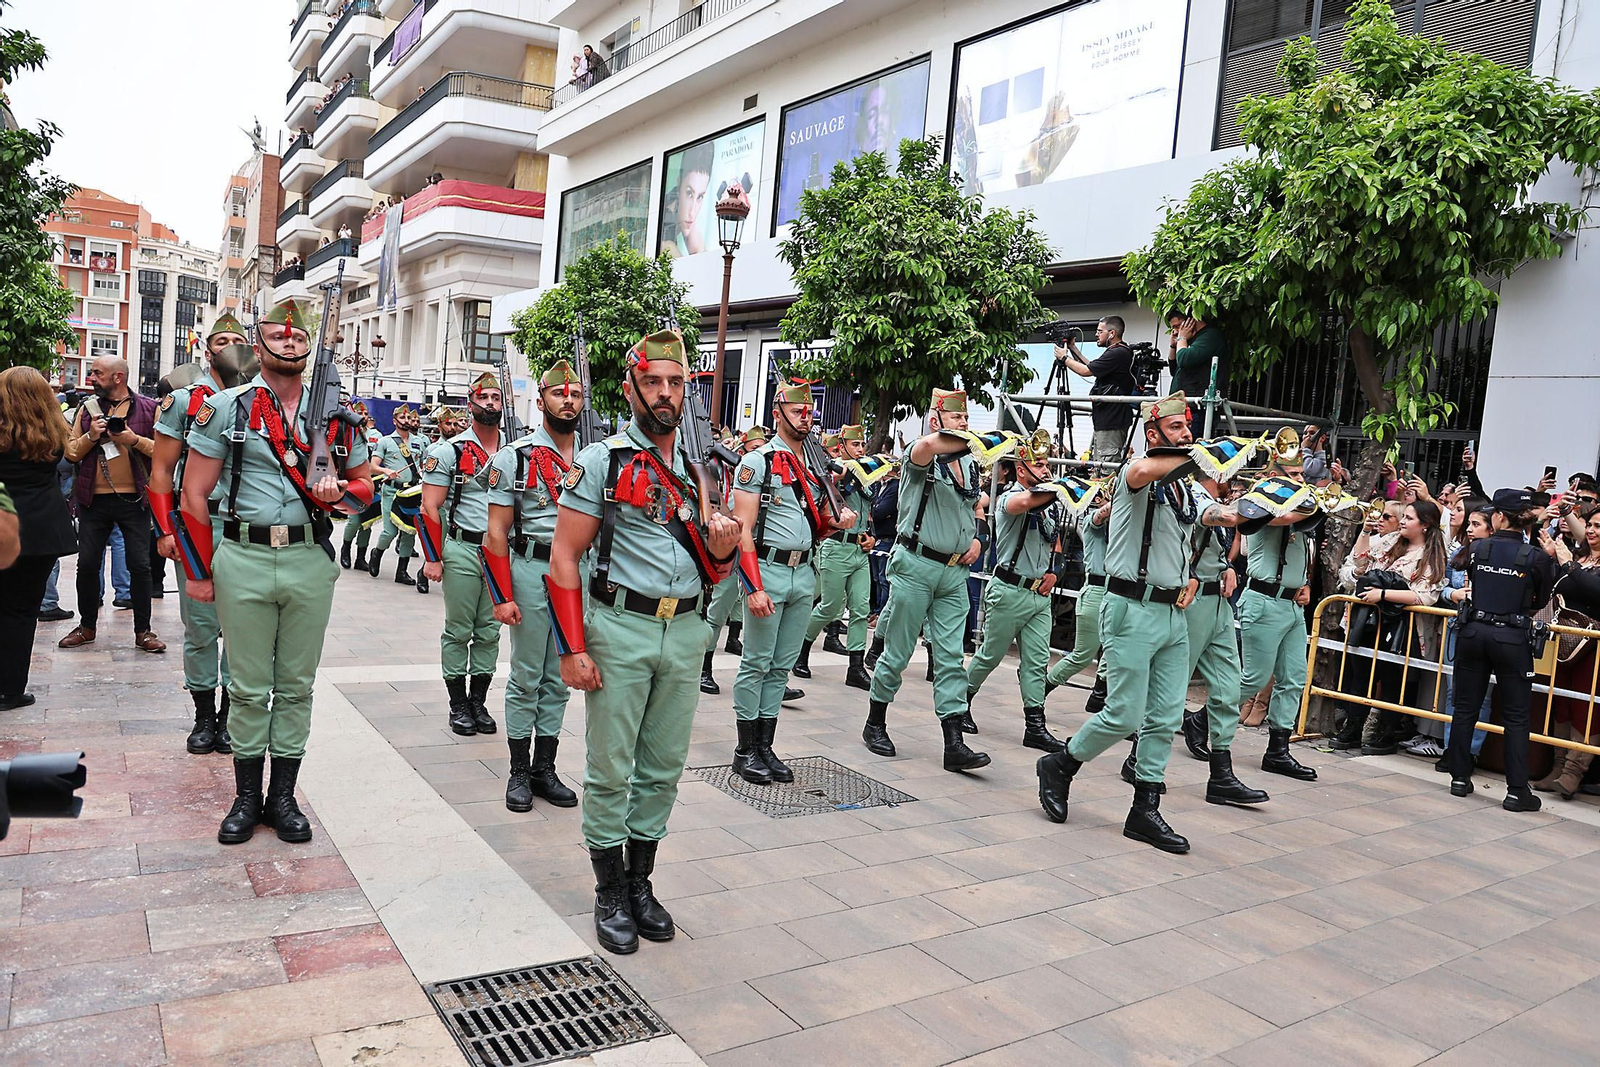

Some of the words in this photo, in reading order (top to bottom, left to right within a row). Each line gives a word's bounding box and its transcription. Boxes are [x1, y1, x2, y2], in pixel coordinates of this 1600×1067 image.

[1113, 48, 1141, 62] HOMME
[789, 115, 846, 146] SAUVAGE
[1477, 564, 1519, 577] POLICIA
